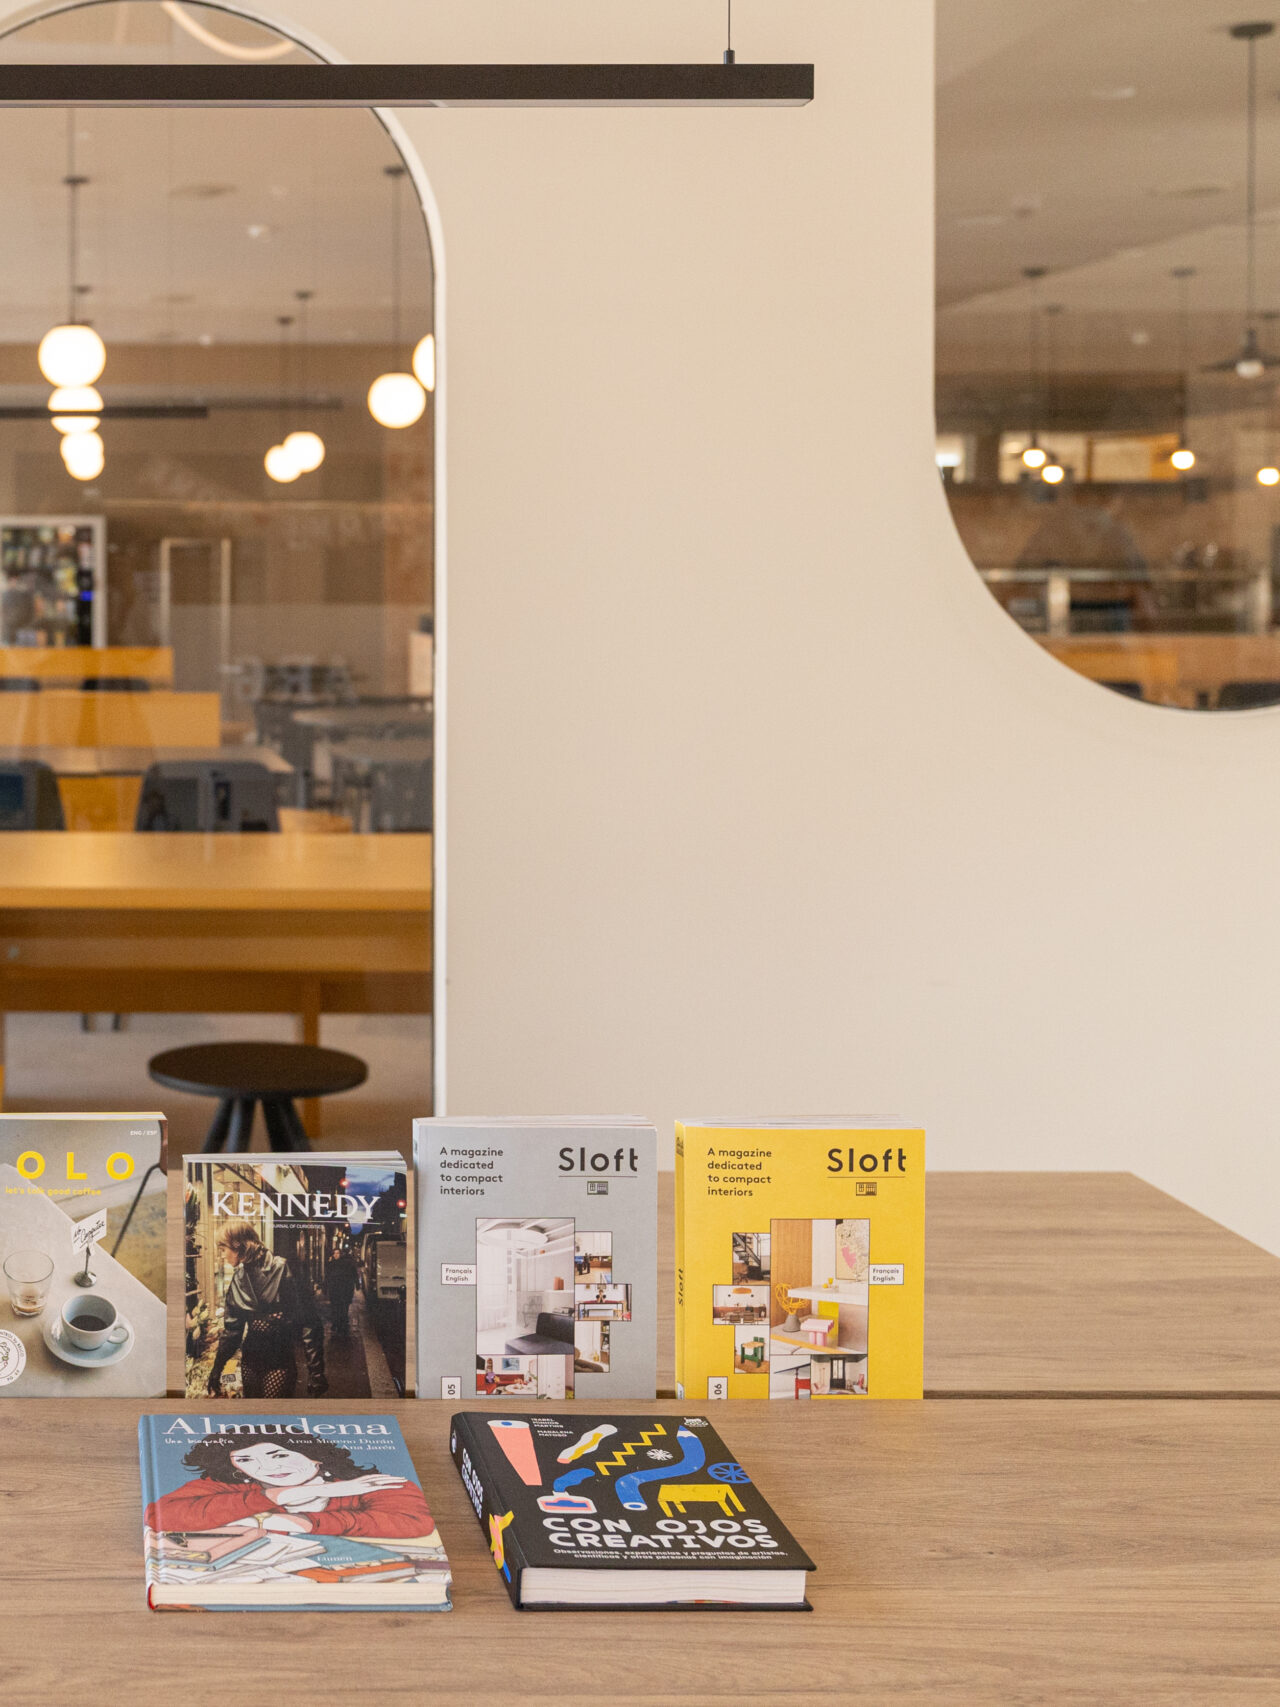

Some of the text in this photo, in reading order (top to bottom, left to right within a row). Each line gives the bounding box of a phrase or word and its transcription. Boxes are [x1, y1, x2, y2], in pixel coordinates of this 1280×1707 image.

[440, 1147, 504, 1158] A magazine
[707, 1147, 772, 1159] A magazine
[440, 1160, 494, 1170] dedicated
[558, 1147, 639, 1173] Sloft
[827, 1148, 907, 1173] Sloft
[707, 1161, 762, 1171] dedicated
[440, 1173, 504, 1184] to compact
[707, 1174, 772, 1186] to compact
[5, 1187, 102, 1197] let's talk good coffee
[440, 1186, 485, 1196] interiors
[707, 1187, 754, 1197] interiors
[212, 1191, 382, 1220] KENNEDY
[445, 1275, 469, 1283] English
[872, 1275, 896, 1283] English
[447, 1384, 456, 1396] 05
[713, 1384, 722, 1396] 06
[162, 1416, 392, 1435] Almudena
[165, 1437, 183, 1445] Una
[542, 1517, 769, 1535] CON OJOS
[548, 1532, 779, 1549] CREATIVOS
